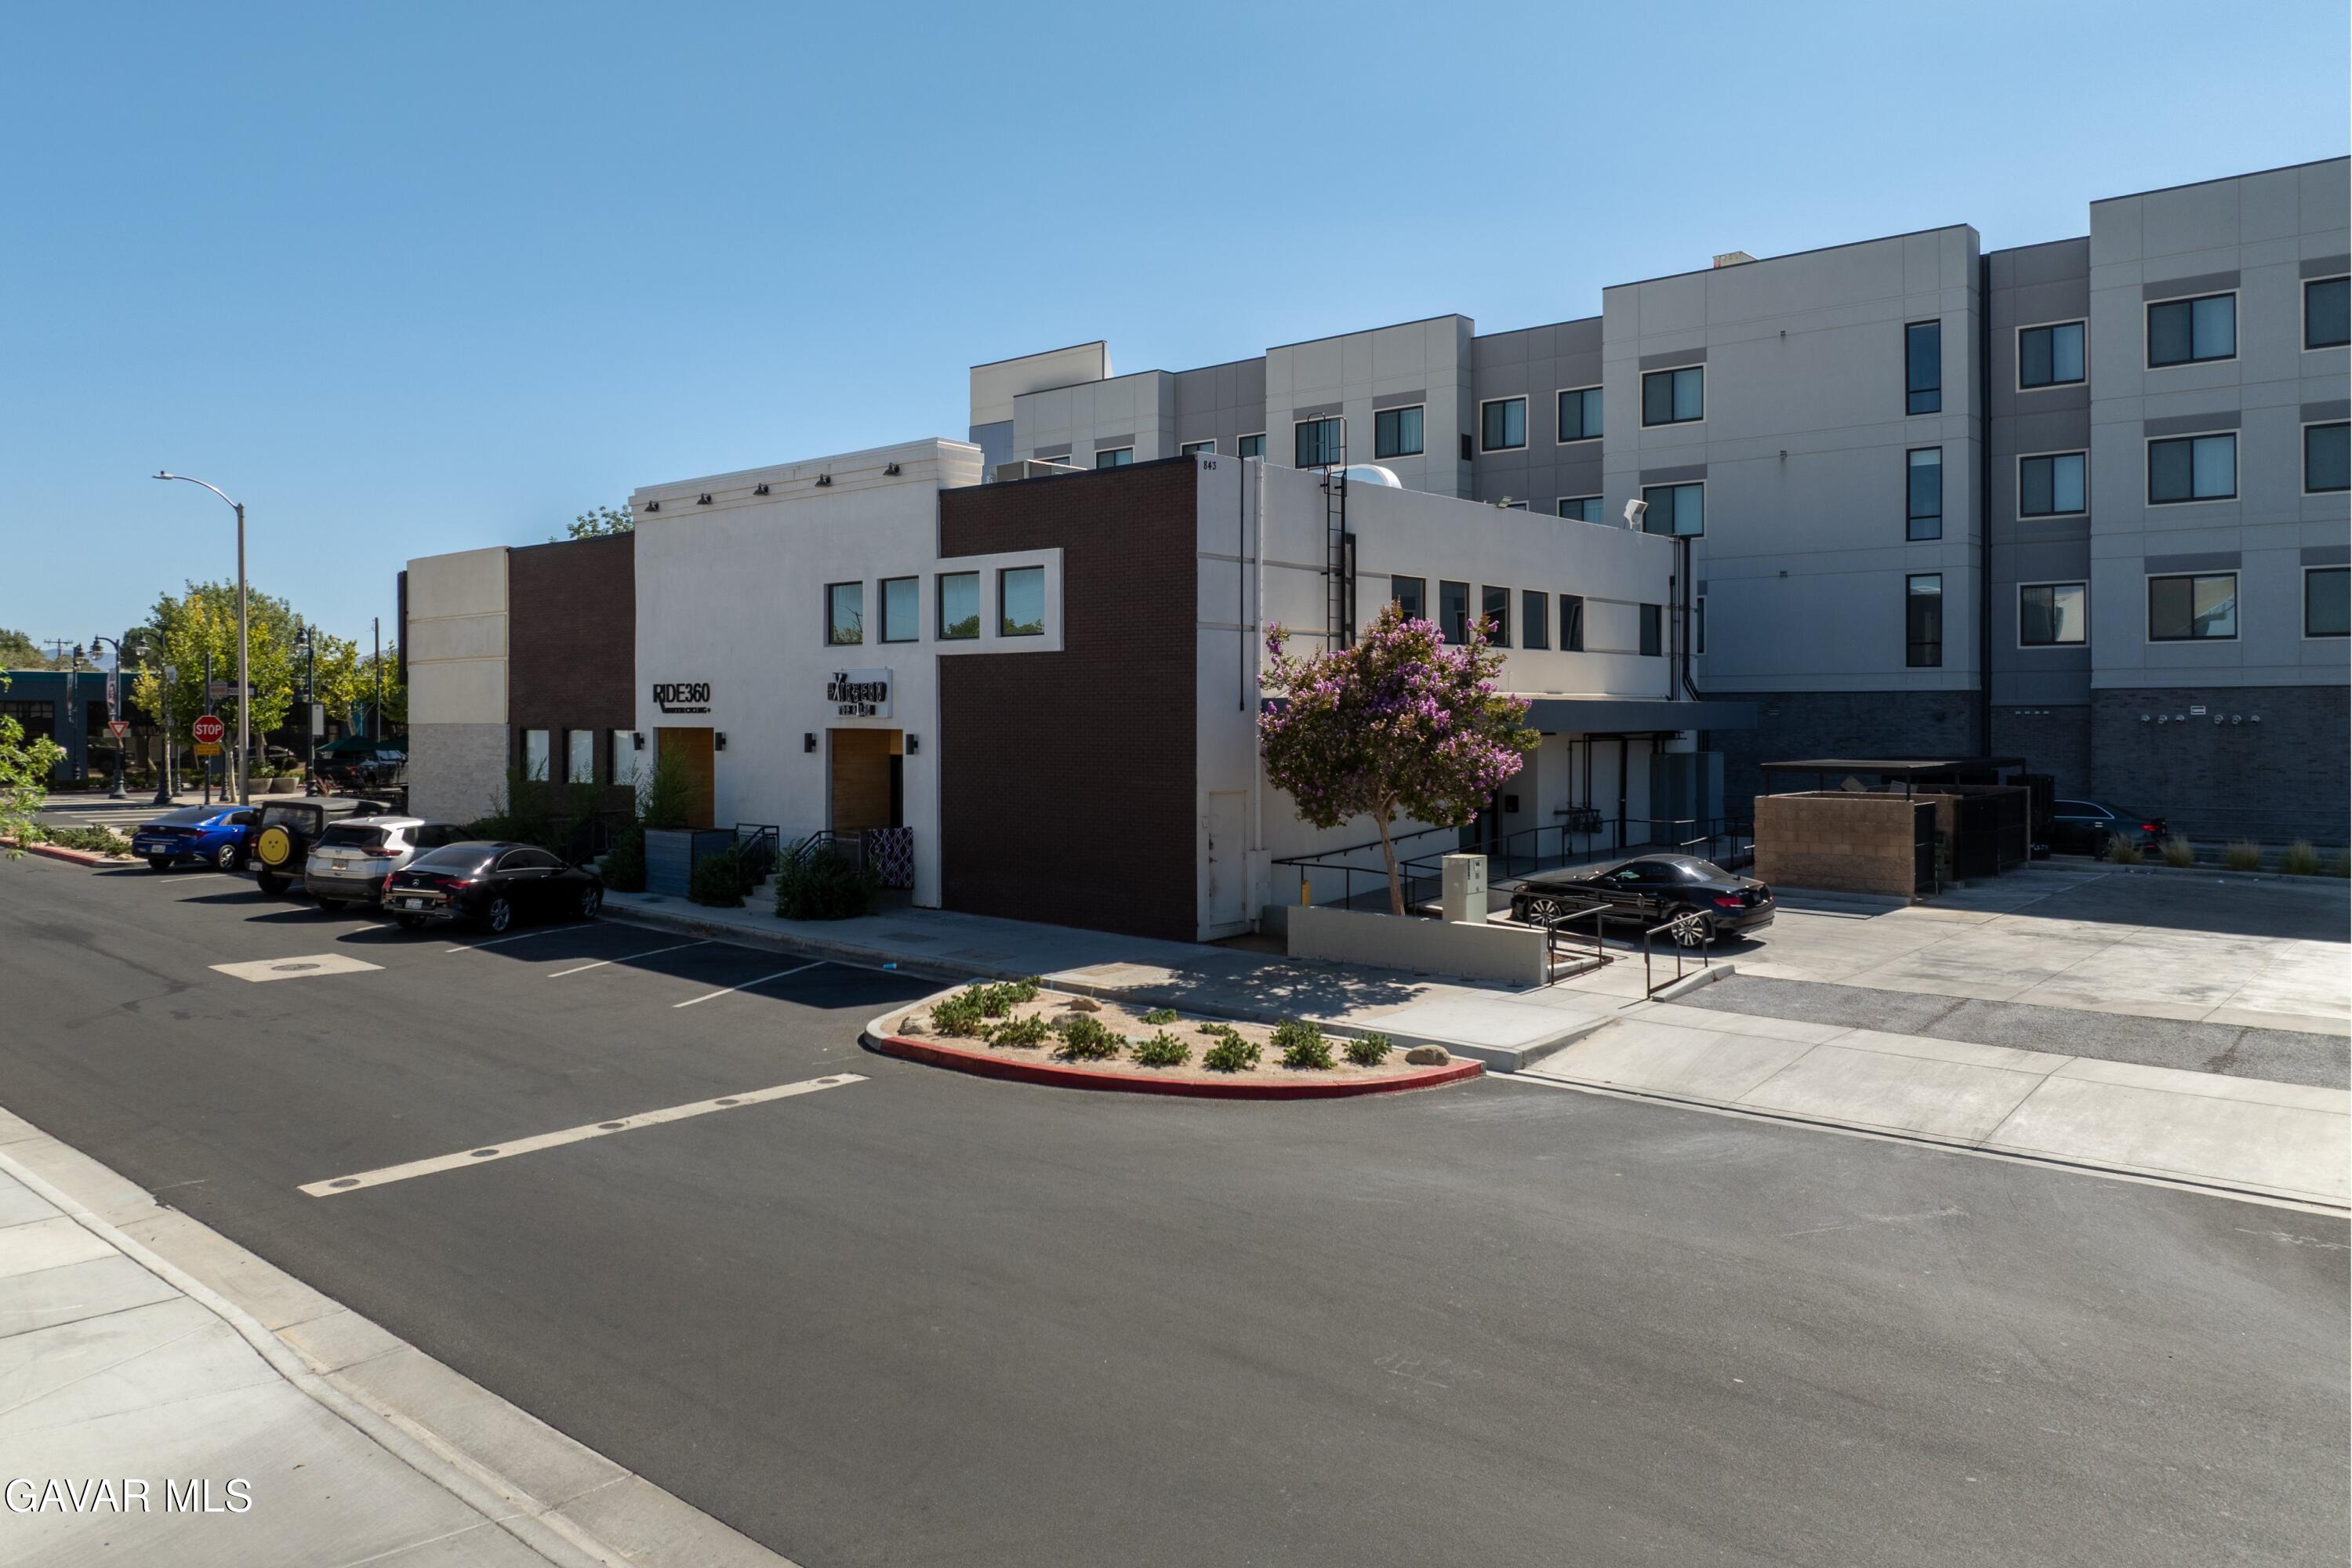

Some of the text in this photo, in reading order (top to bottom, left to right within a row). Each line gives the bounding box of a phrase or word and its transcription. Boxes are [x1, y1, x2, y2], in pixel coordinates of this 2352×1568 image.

[1203, 460, 1217, 470] 843
[652, 682, 710, 703] RIDE360
[195, 724, 222, 735] STOP
